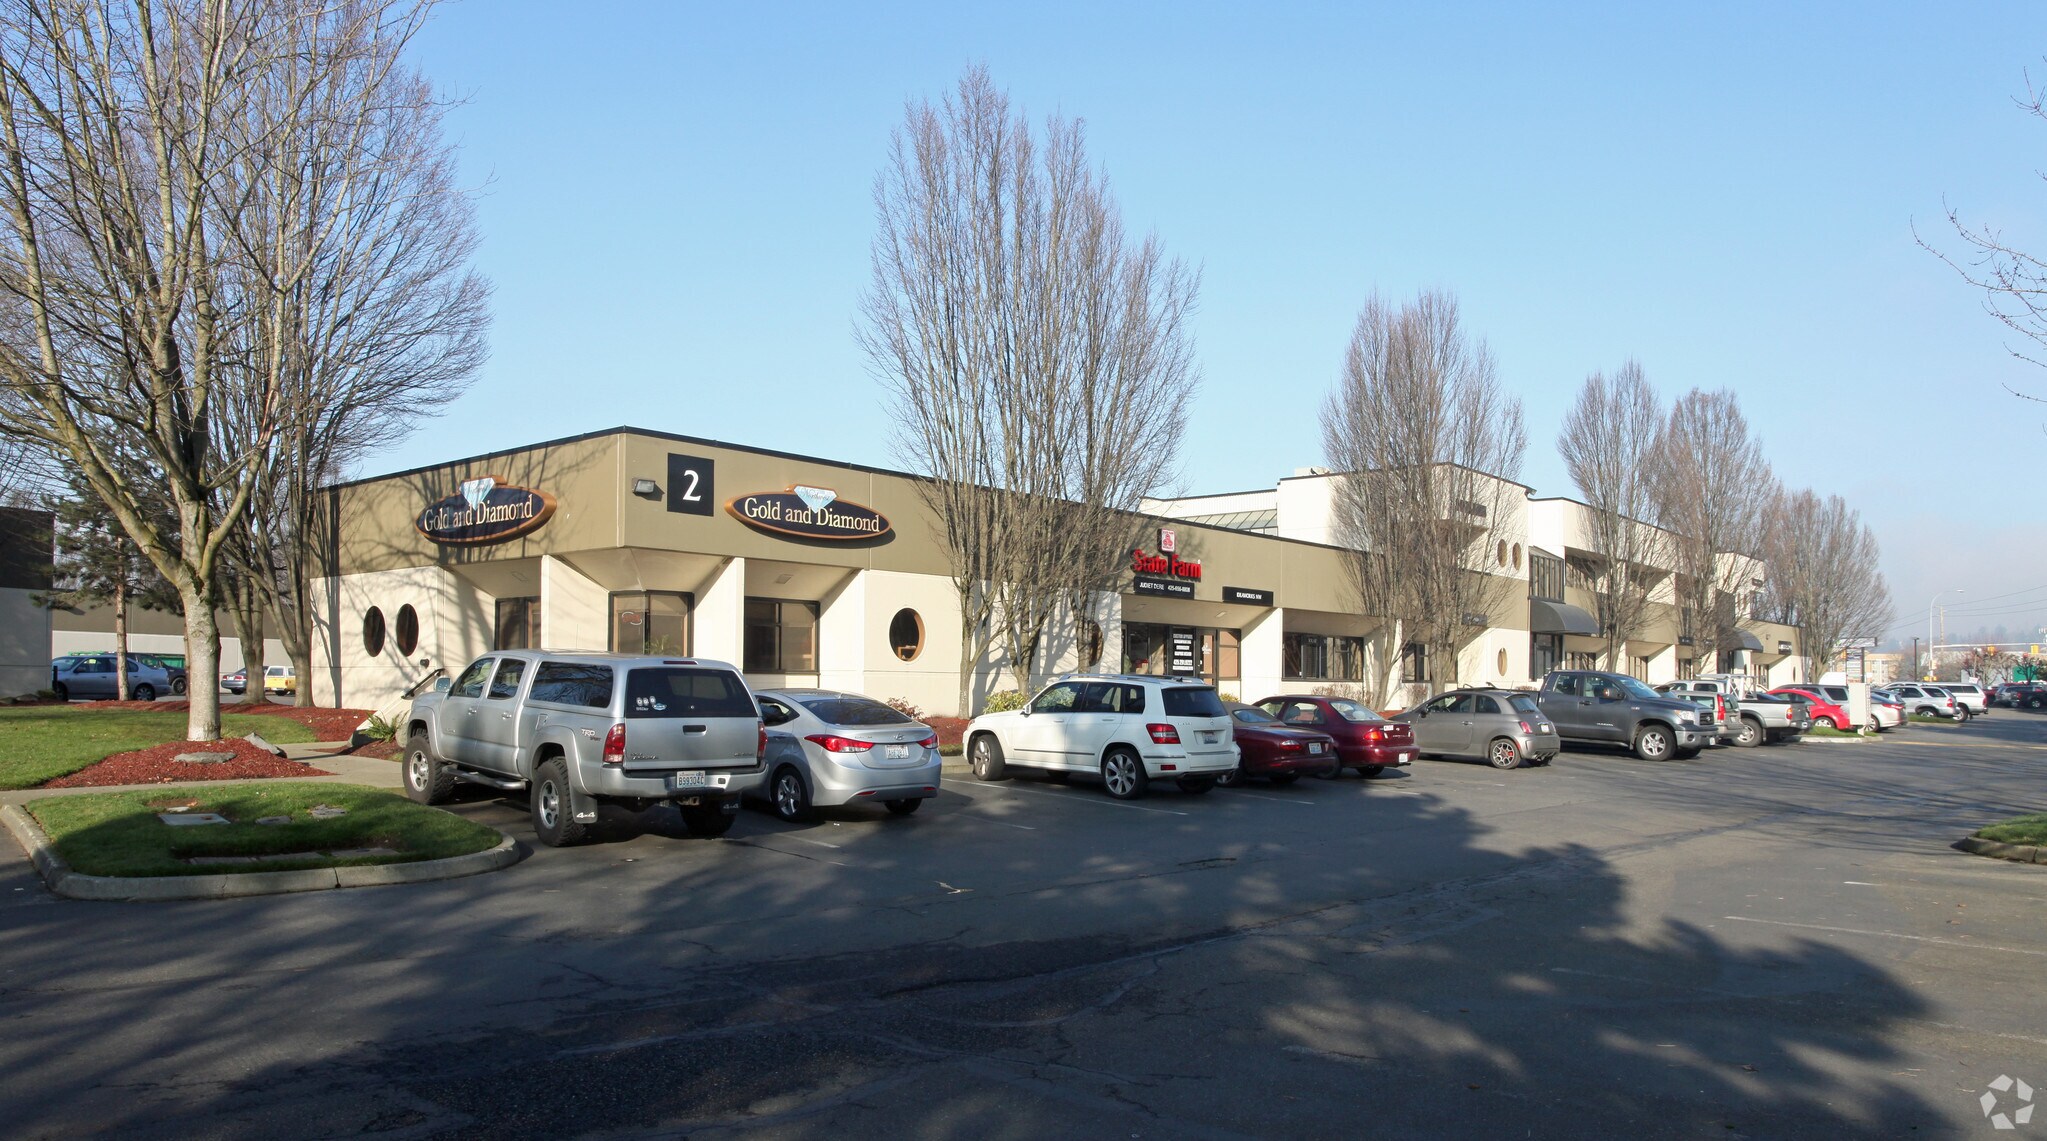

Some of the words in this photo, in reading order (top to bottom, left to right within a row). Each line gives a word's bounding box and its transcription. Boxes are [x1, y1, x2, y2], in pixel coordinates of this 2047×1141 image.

[683, 470, 701, 501] 2
[424, 506, 449, 532] Gold
[453, 502, 472, 528] and
[476, 493, 533, 525] Diamond
[744, 497, 781, 521] Gold
[785, 506, 812, 525] and
[816, 507, 880, 532] Diamond
[1132, 549, 1167, 575] State
[1171, 554, 1201, 578] Farm
[581, 728, 596, 737] TRD
